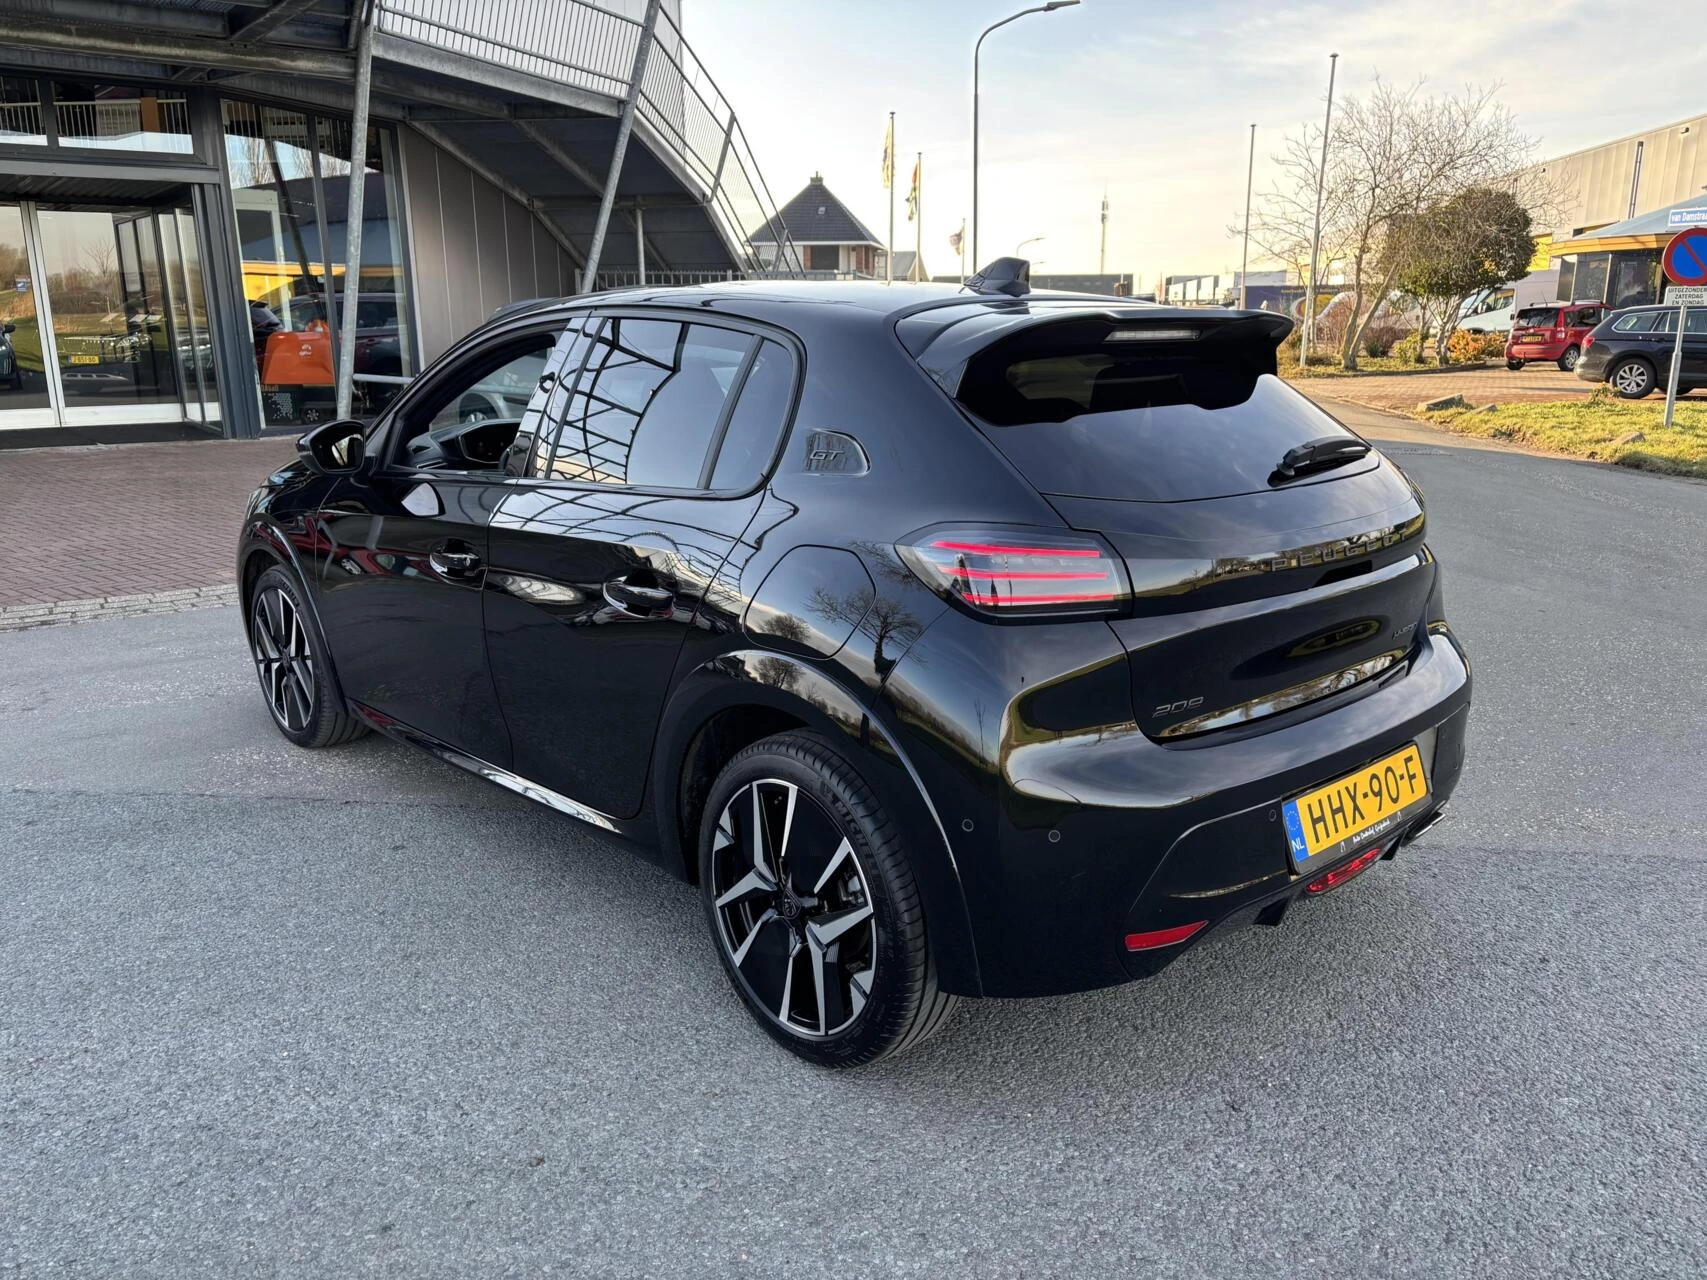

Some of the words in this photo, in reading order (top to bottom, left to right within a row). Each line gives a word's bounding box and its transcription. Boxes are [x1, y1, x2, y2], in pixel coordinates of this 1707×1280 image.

[810, 449, 845, 461] GT
[1151, 696, 1204, 718] 208
[1307, 755, 1417, 844] HHX-90-F
[1291, 837, 1305, 852] NL
